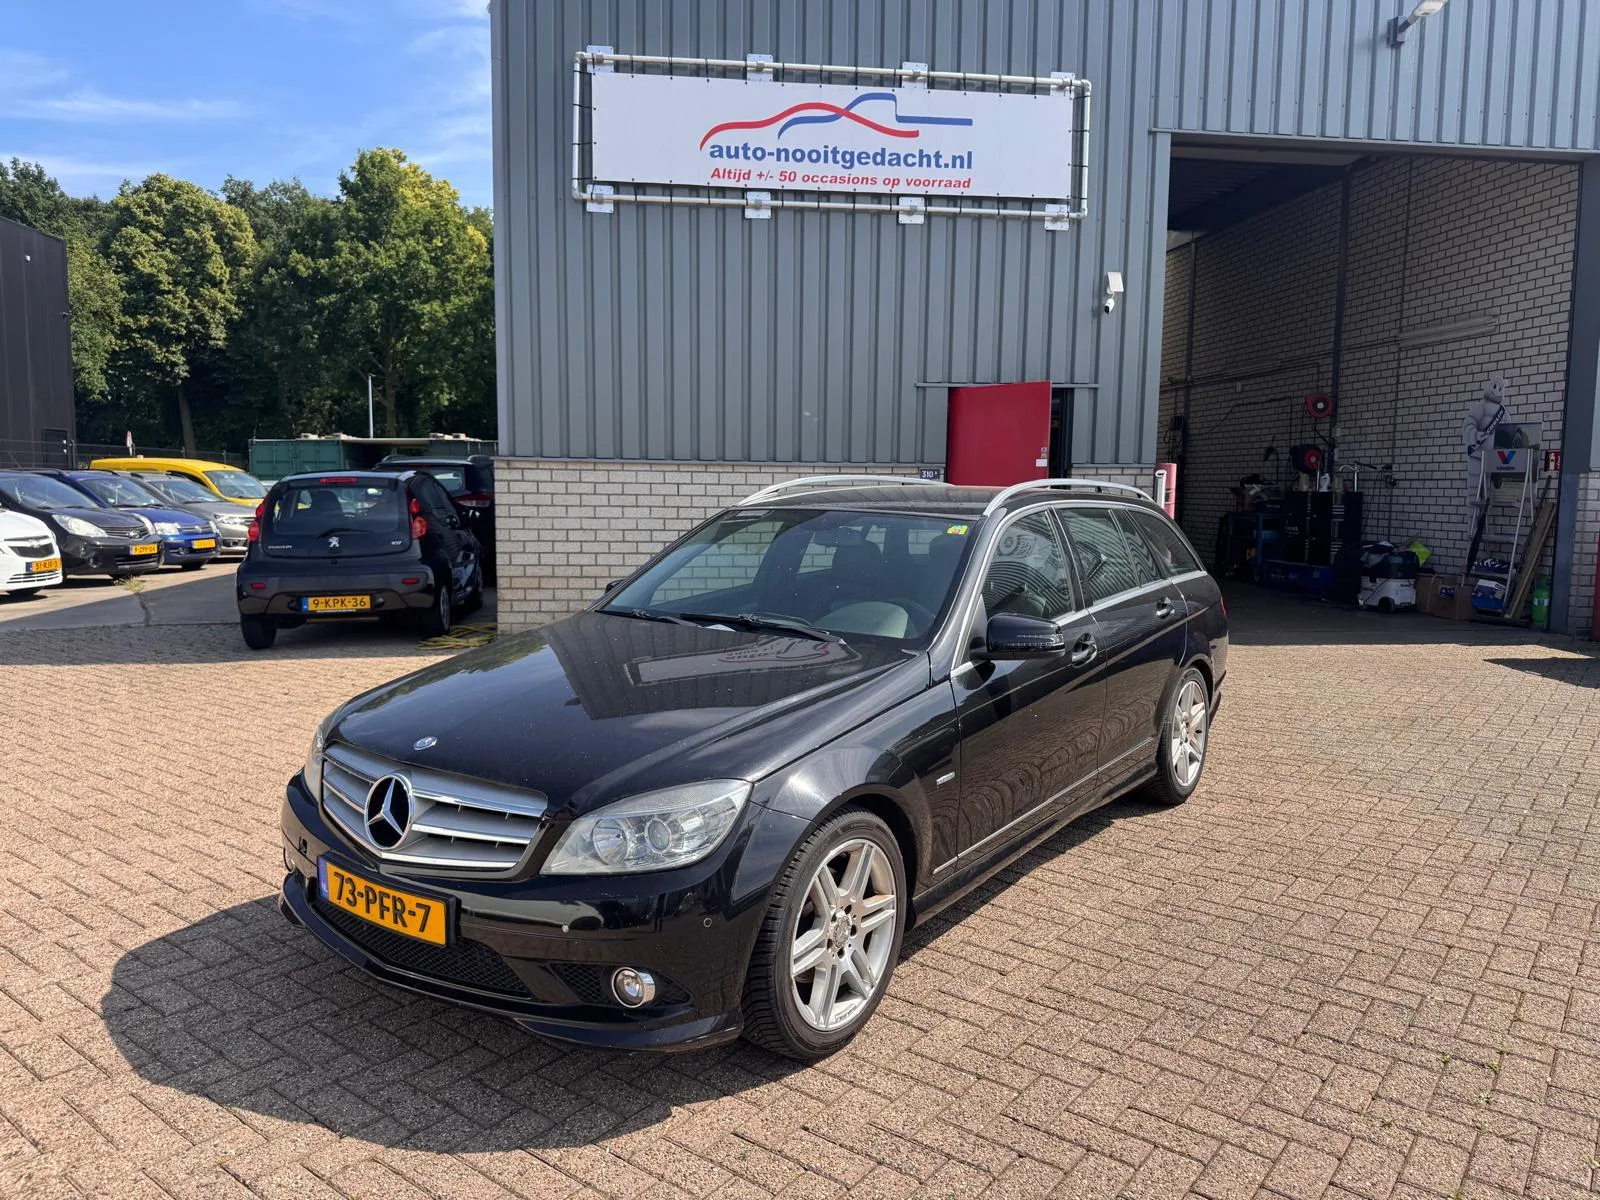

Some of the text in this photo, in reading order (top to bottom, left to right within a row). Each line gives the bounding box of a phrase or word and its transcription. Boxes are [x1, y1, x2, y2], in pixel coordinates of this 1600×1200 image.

[709, 142, 973, 170] auto-nooitgedacht.nl
[711, 167, 971, 189] Altijd +/- 50 occasions op voorraad
[312, 597, 366, 608] 9-KPK-36
[334, 871, 432, 933] 73-PFR-7
